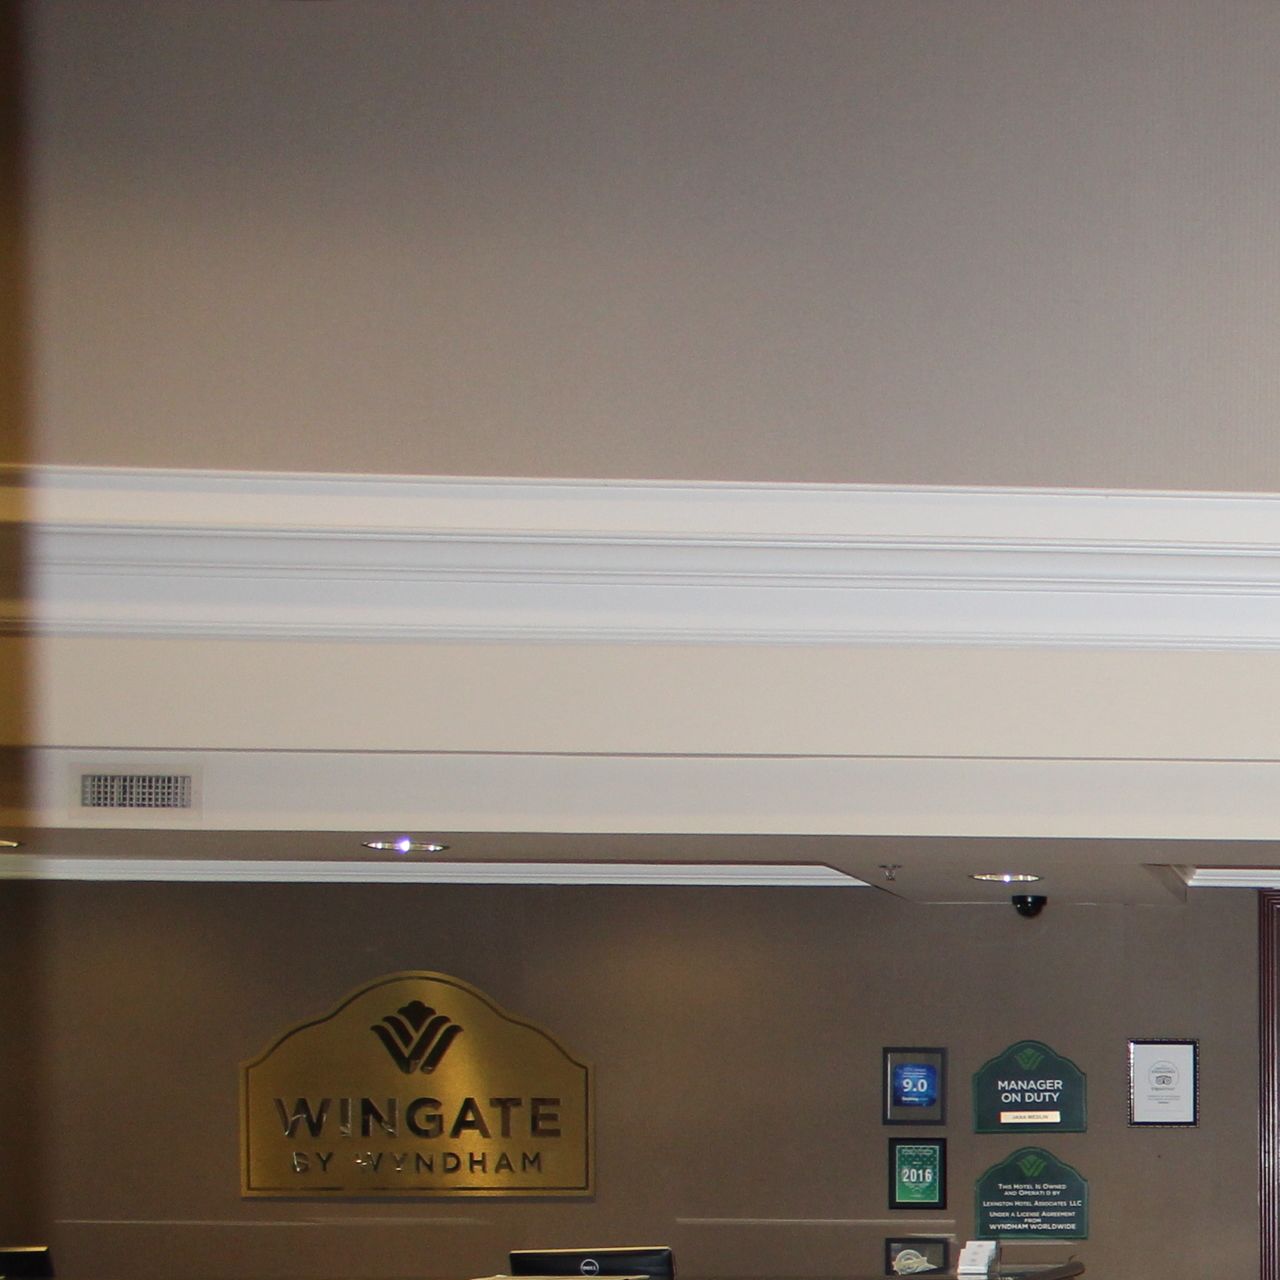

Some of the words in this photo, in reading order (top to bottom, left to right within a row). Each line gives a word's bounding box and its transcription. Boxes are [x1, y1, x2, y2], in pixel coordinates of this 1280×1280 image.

[902, 1078, 928, 1092] 9.0
[997, 1080, 1063, 1090] MANAGER
[1001, 1092, 1021, 1103] ON
[1025, 1092, 1060, 1102] DUTY
[273, 1097, 562, 1139] WINGATE
[293, 1152, 334, 1174] BY
[355, 1152, 543, 1174] WYNDHAM
[902, 1168, 932, 1182] 2016
